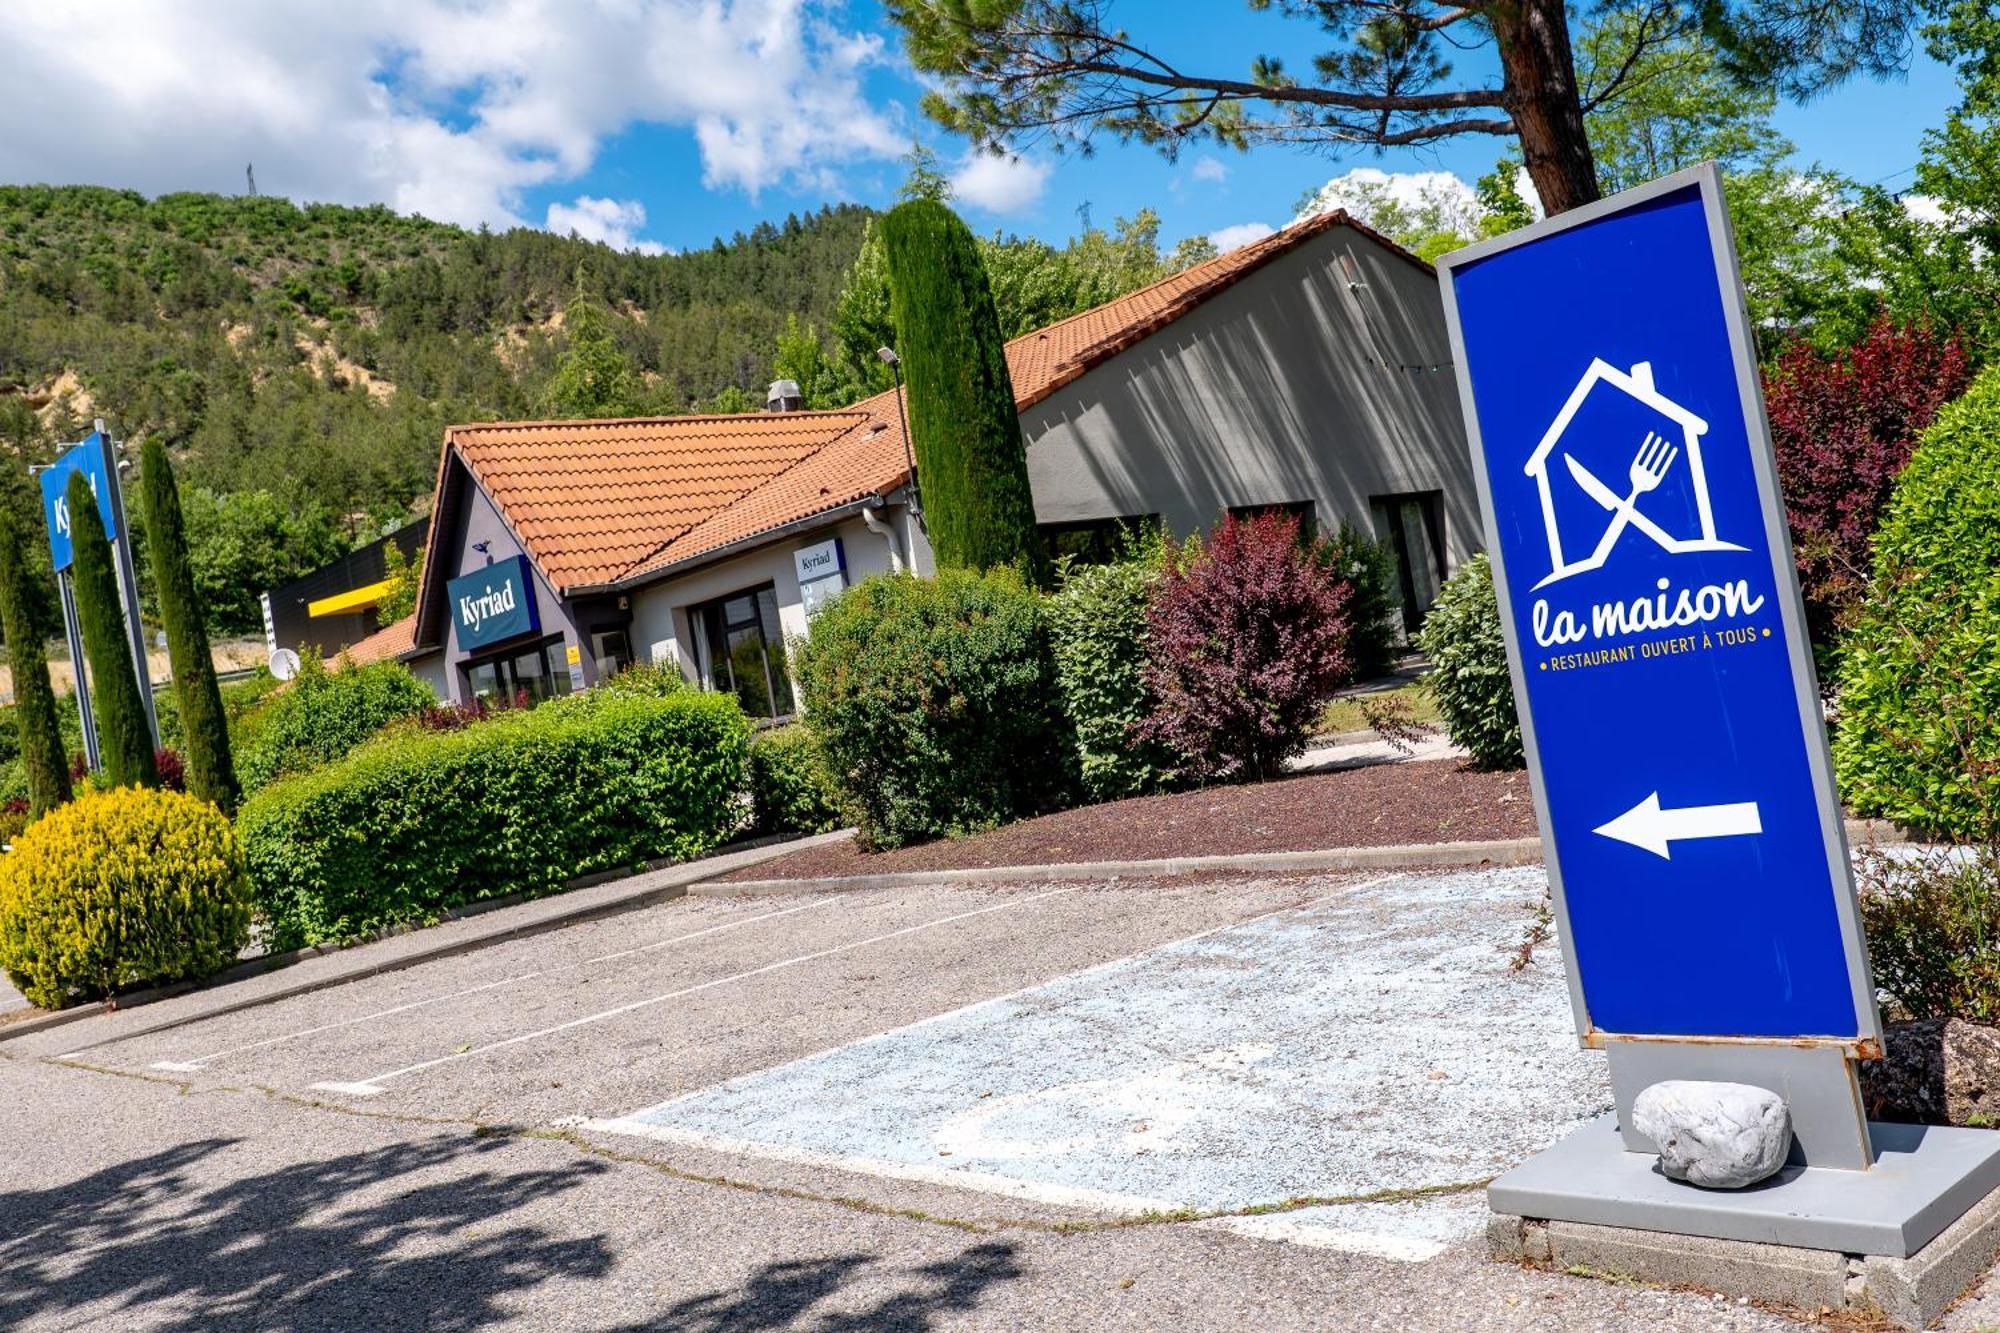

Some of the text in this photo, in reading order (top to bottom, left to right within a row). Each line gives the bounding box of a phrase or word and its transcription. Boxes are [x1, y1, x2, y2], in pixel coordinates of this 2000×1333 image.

[802, 550, 831, 572] Kyriad
[459, 578, 516, 632] Kyriad
[1532, 577, 1765, 648] la maison
[1551, 626, 1757, 671] RESTAURANT OUVERT À TOUS
